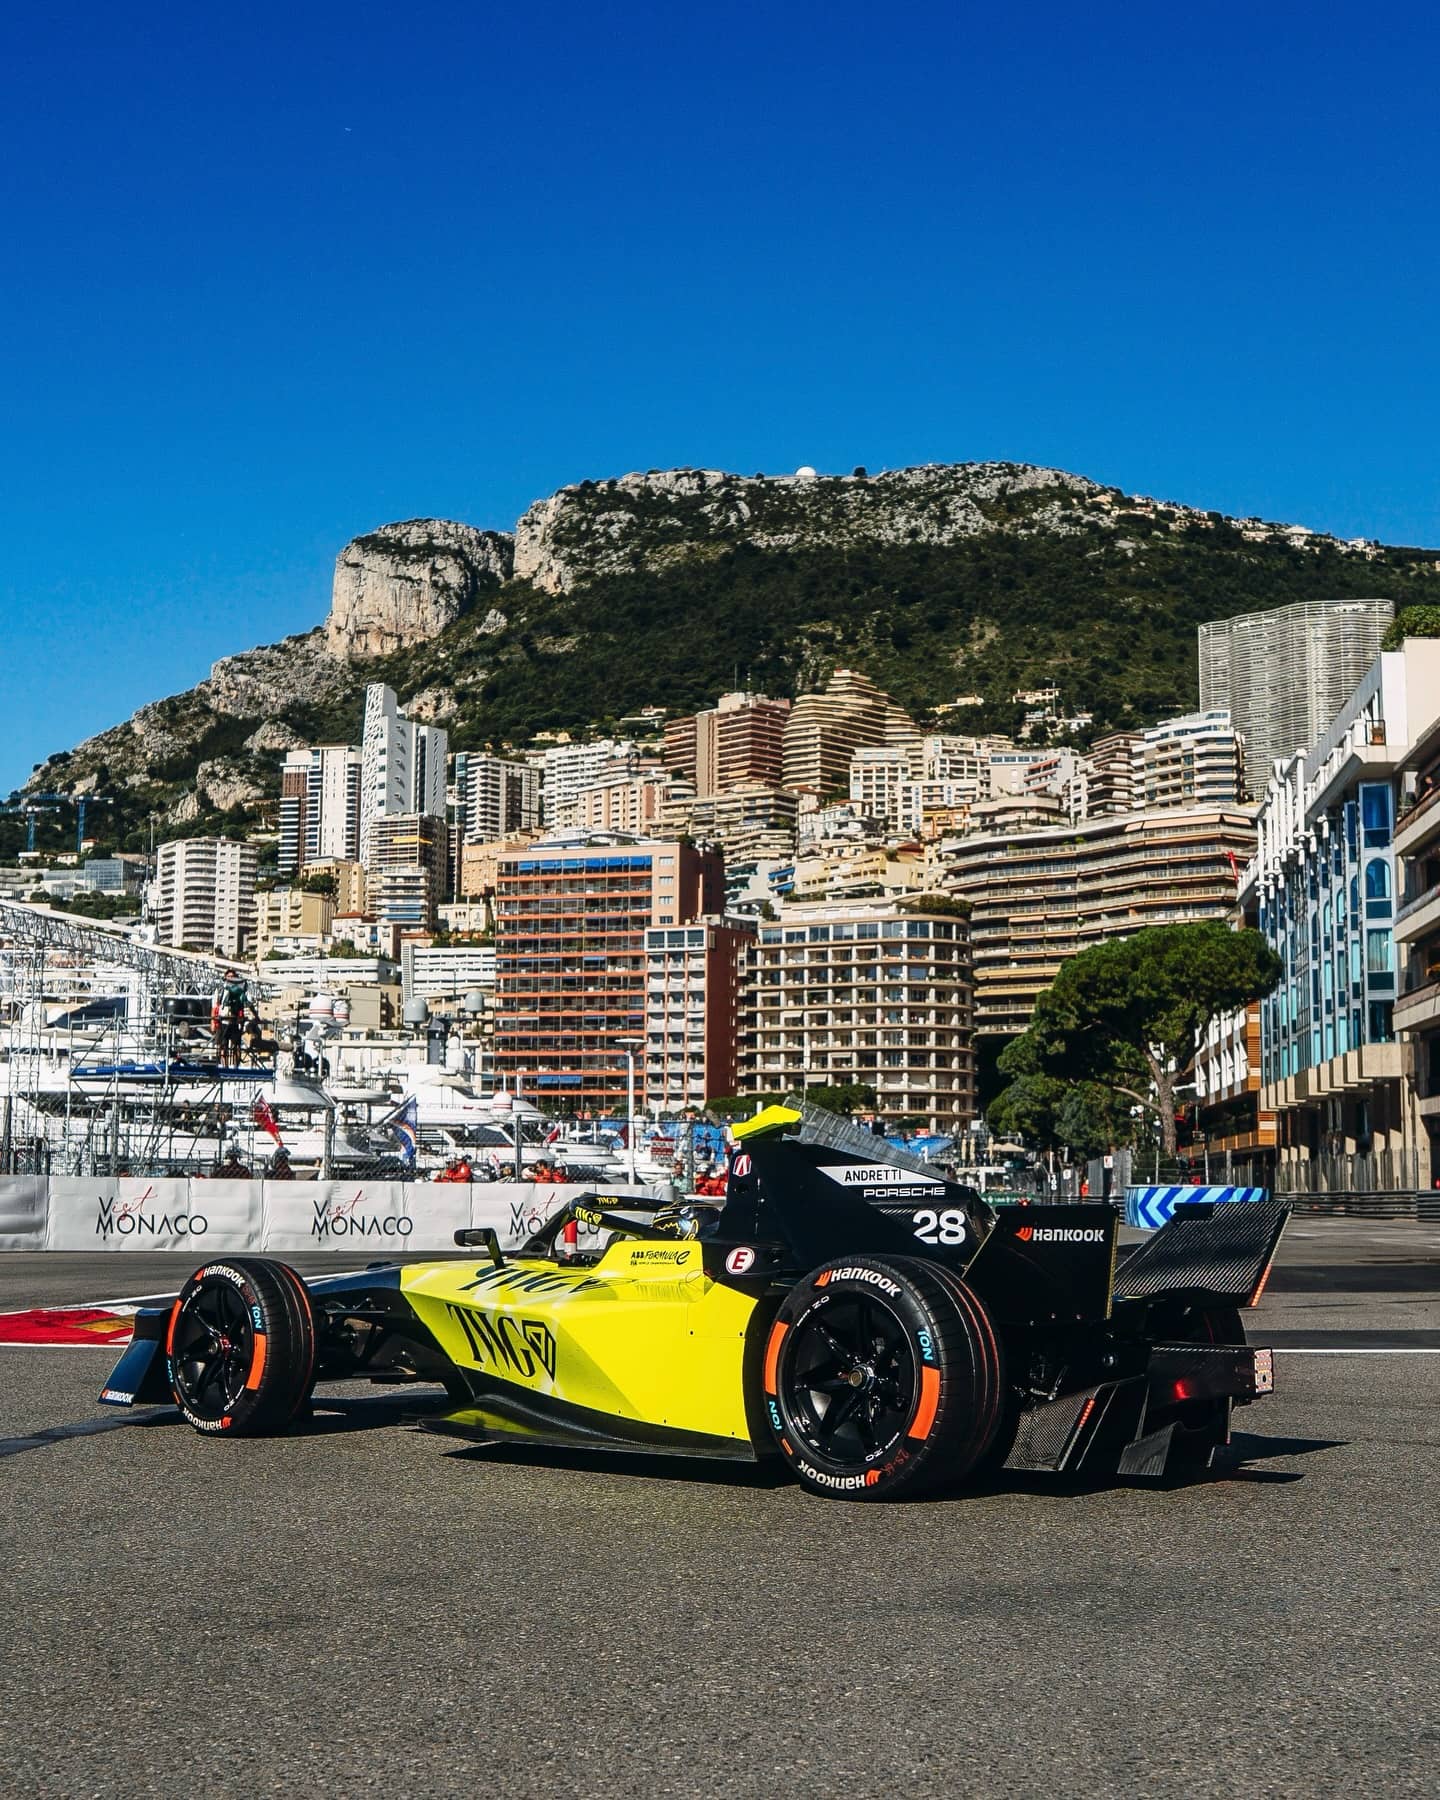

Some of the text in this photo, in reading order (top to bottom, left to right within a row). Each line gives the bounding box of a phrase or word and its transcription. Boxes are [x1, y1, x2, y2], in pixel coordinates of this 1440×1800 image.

[844, 1169, 901, 1182] ANDRETTI
[98, 1186, 158, 1220] Visit
[863, 1187, 946, 1198] PORSCHE
[313, 1190, 368, 1223] Visit
[510, 1192, 560, 1223] Visit
[96, 1213, 208, 1237] MONACO
[311, 1216, 413, 1237] MONACO
[913, 1210, 966, 1244] 28
[646, 1250, 679, 1260] FORMULA
[445, 1303, 536, 1378] TWG
